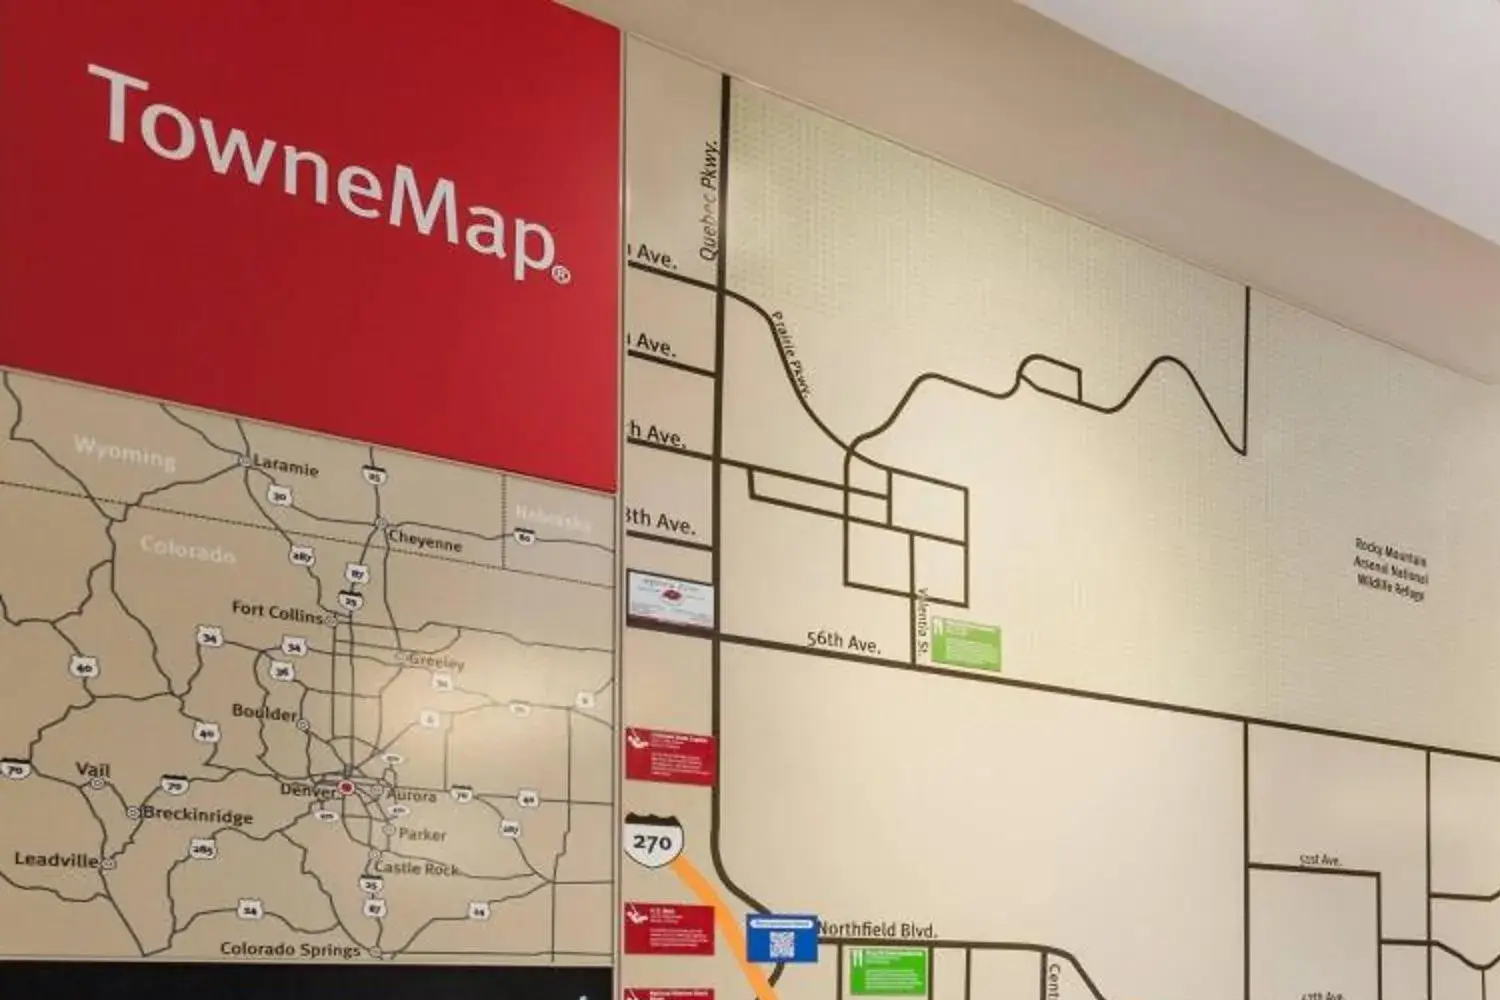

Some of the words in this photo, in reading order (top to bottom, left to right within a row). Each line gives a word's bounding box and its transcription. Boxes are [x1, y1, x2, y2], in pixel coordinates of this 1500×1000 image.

[700, 140, 720, 190] Pkwy.
[700, 192, 720, 261] Quebec
[638, 244, 678, 270] Ave.
[636, 332, 677, 358] Ave.
[648, 425, 687, 449] Ave.
[73, 434, 176, 473] Wyoming
[253, 453, 319, 478] Laramie
[657, 512, 696, 536] Ave.
[140, 535, 237, 564] Colorado
[389, 529, 463, 552] Cheyenne
[1355, 537, 1382, 557] Rocky
[232, 600, 264, 618] Fort
[269, 605, 323, 626] Collins
[807, 630, 844, 649] 56th
[848, 634, 882, 655] Ave.
[408, 654, 465, 673] Greeley
[232, 703, 297, 724] Boulder
[76, 762, 111, 778] Vail
[280, 782, 337, 801] Denver
[387, 789, 437, 803] Aurora
[142, 805, 253, 827] Breckinridge
[399, 827, 446, 842] Parker
[633, 835, 672, 854] 270
[15, 852, 99, 870] Leadville
[375, 857, 420, 875] Castle
[425, 863, 459, 877] Rock
[1322, 855, 1343, 867] Ave.
[816, 920, 896, 938] Northfield
[900, 922, 939, 939] Blvd.
[220, 941, 295, 956] Colorado
[300, 943, 361, 960] Springs
